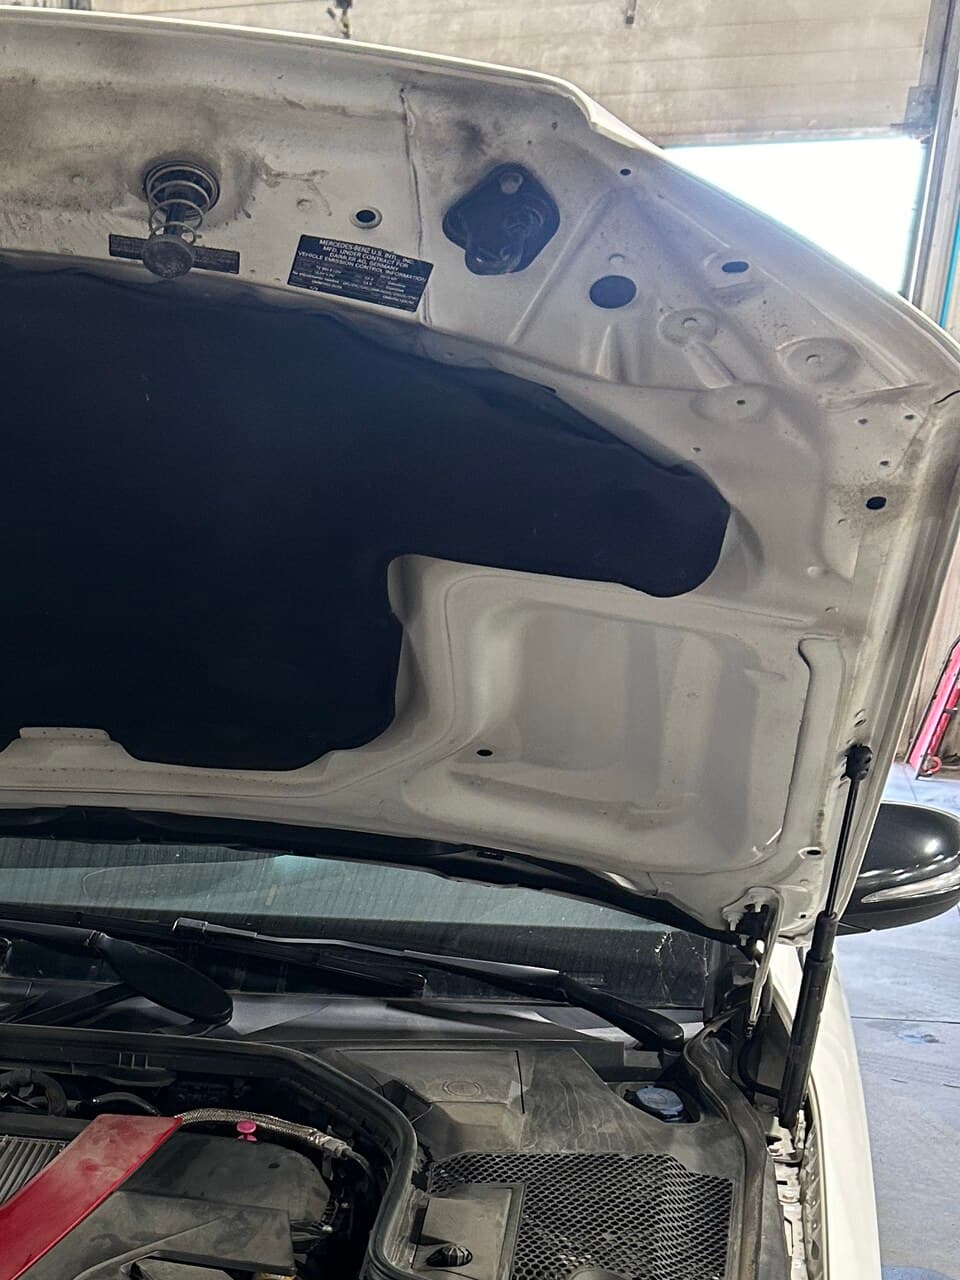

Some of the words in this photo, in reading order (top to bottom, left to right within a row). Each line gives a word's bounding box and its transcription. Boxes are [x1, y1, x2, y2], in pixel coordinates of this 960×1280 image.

[339, 248, 361, 258] UNDER
[361, 253, 395, 265] CONTRACT
[354, 262, 384, 273] CONTROL
